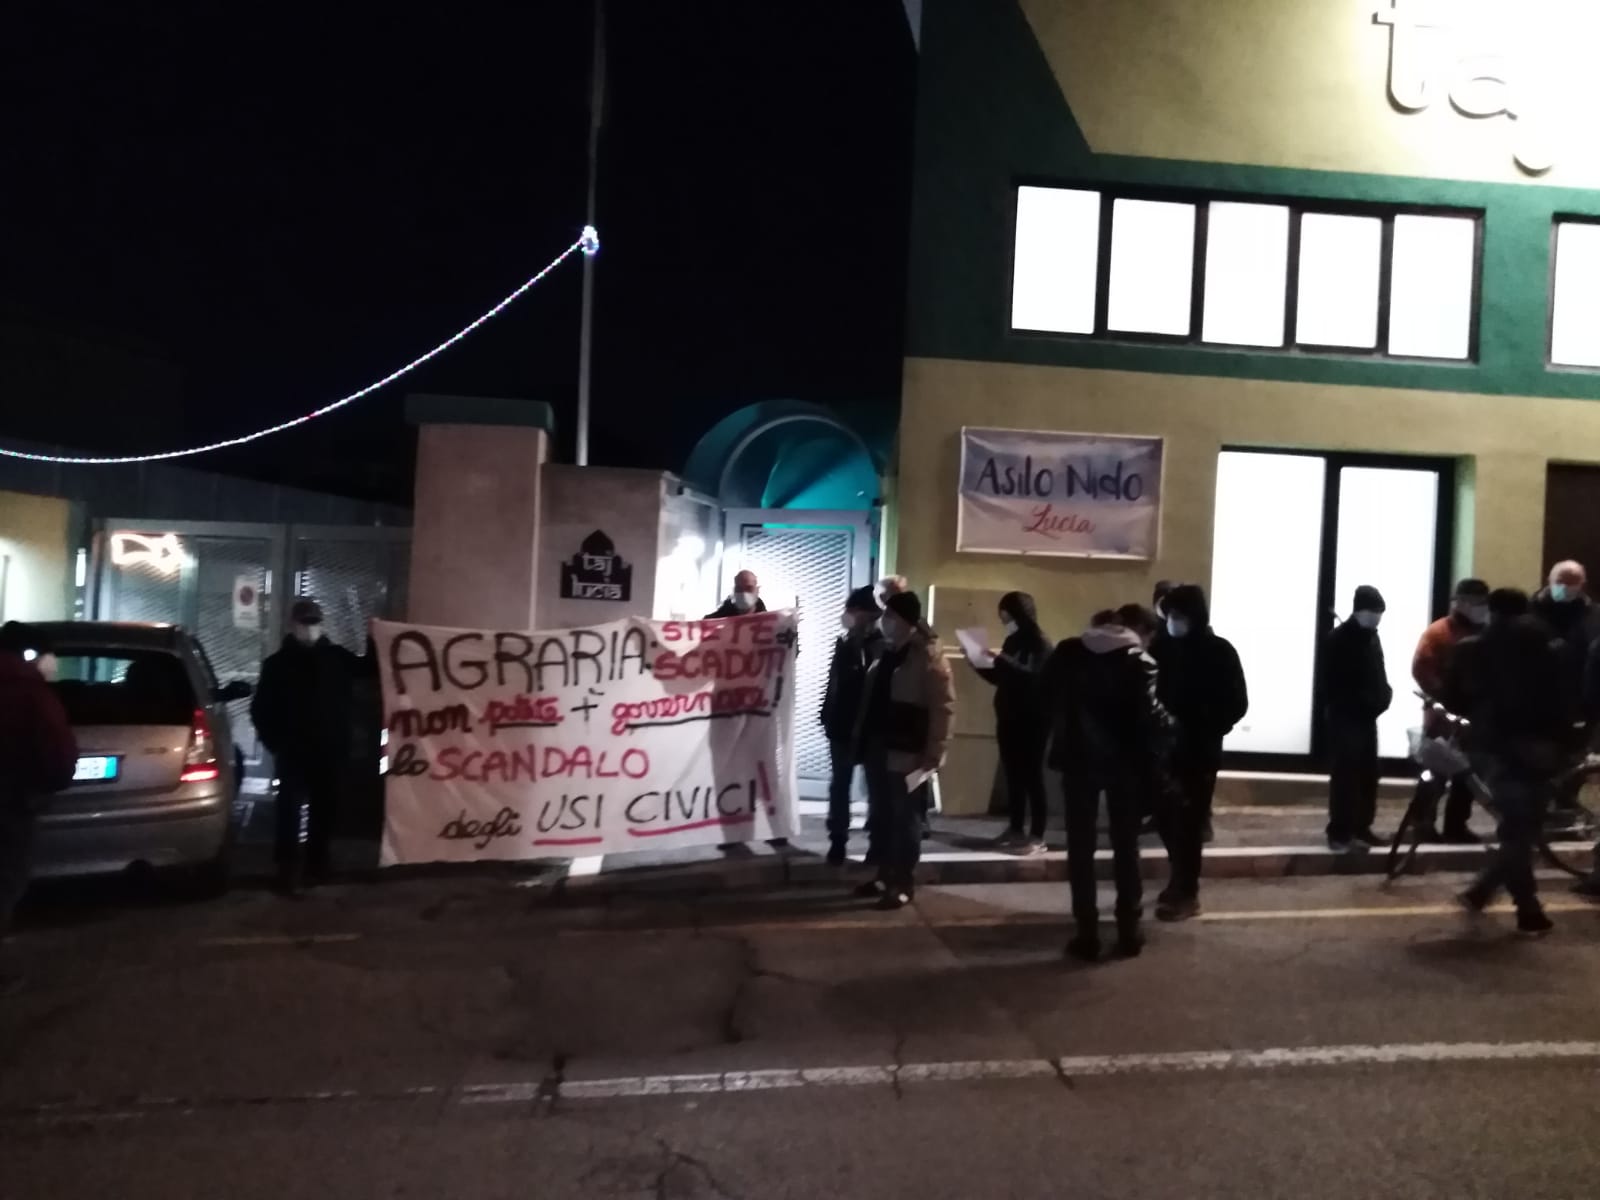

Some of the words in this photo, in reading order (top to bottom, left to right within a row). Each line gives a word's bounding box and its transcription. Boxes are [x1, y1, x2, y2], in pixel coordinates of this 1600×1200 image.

[975, 455, 1054, 498] Asilo
[1066, 460, 1144, 501] Nido
[1022, 502, 1096, 540] Lucia
[661, 613, 779, 644] SIETE
[428, 743, 649, 783] SCANDALO
[437, 807, 523, 850] degli
[537, 794, 603, 833] USI
